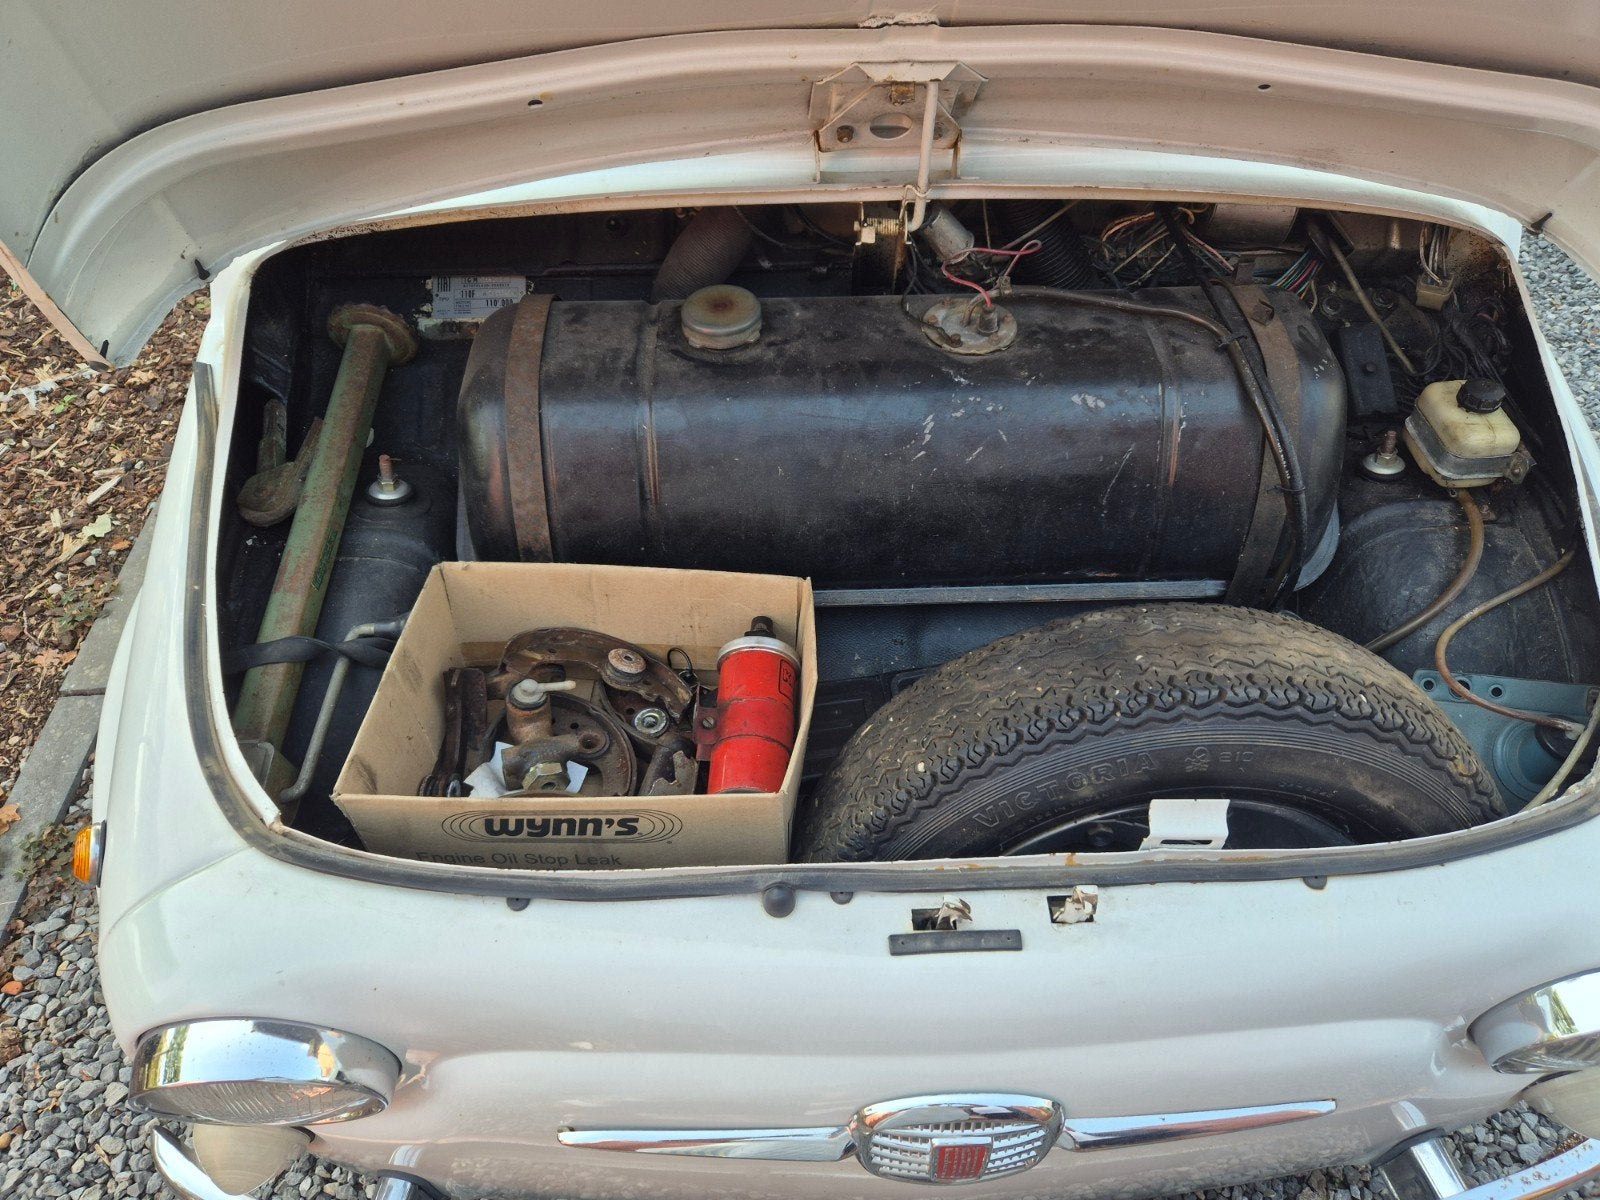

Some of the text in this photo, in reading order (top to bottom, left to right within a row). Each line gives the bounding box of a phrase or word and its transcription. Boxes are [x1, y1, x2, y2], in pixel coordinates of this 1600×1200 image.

[973, 752, 1158, 827] VICTORIA
[491, 853, 517, 865] Oil
[524, 853, 568, 867] Stop
[575, 853, 622, 866] Leak
